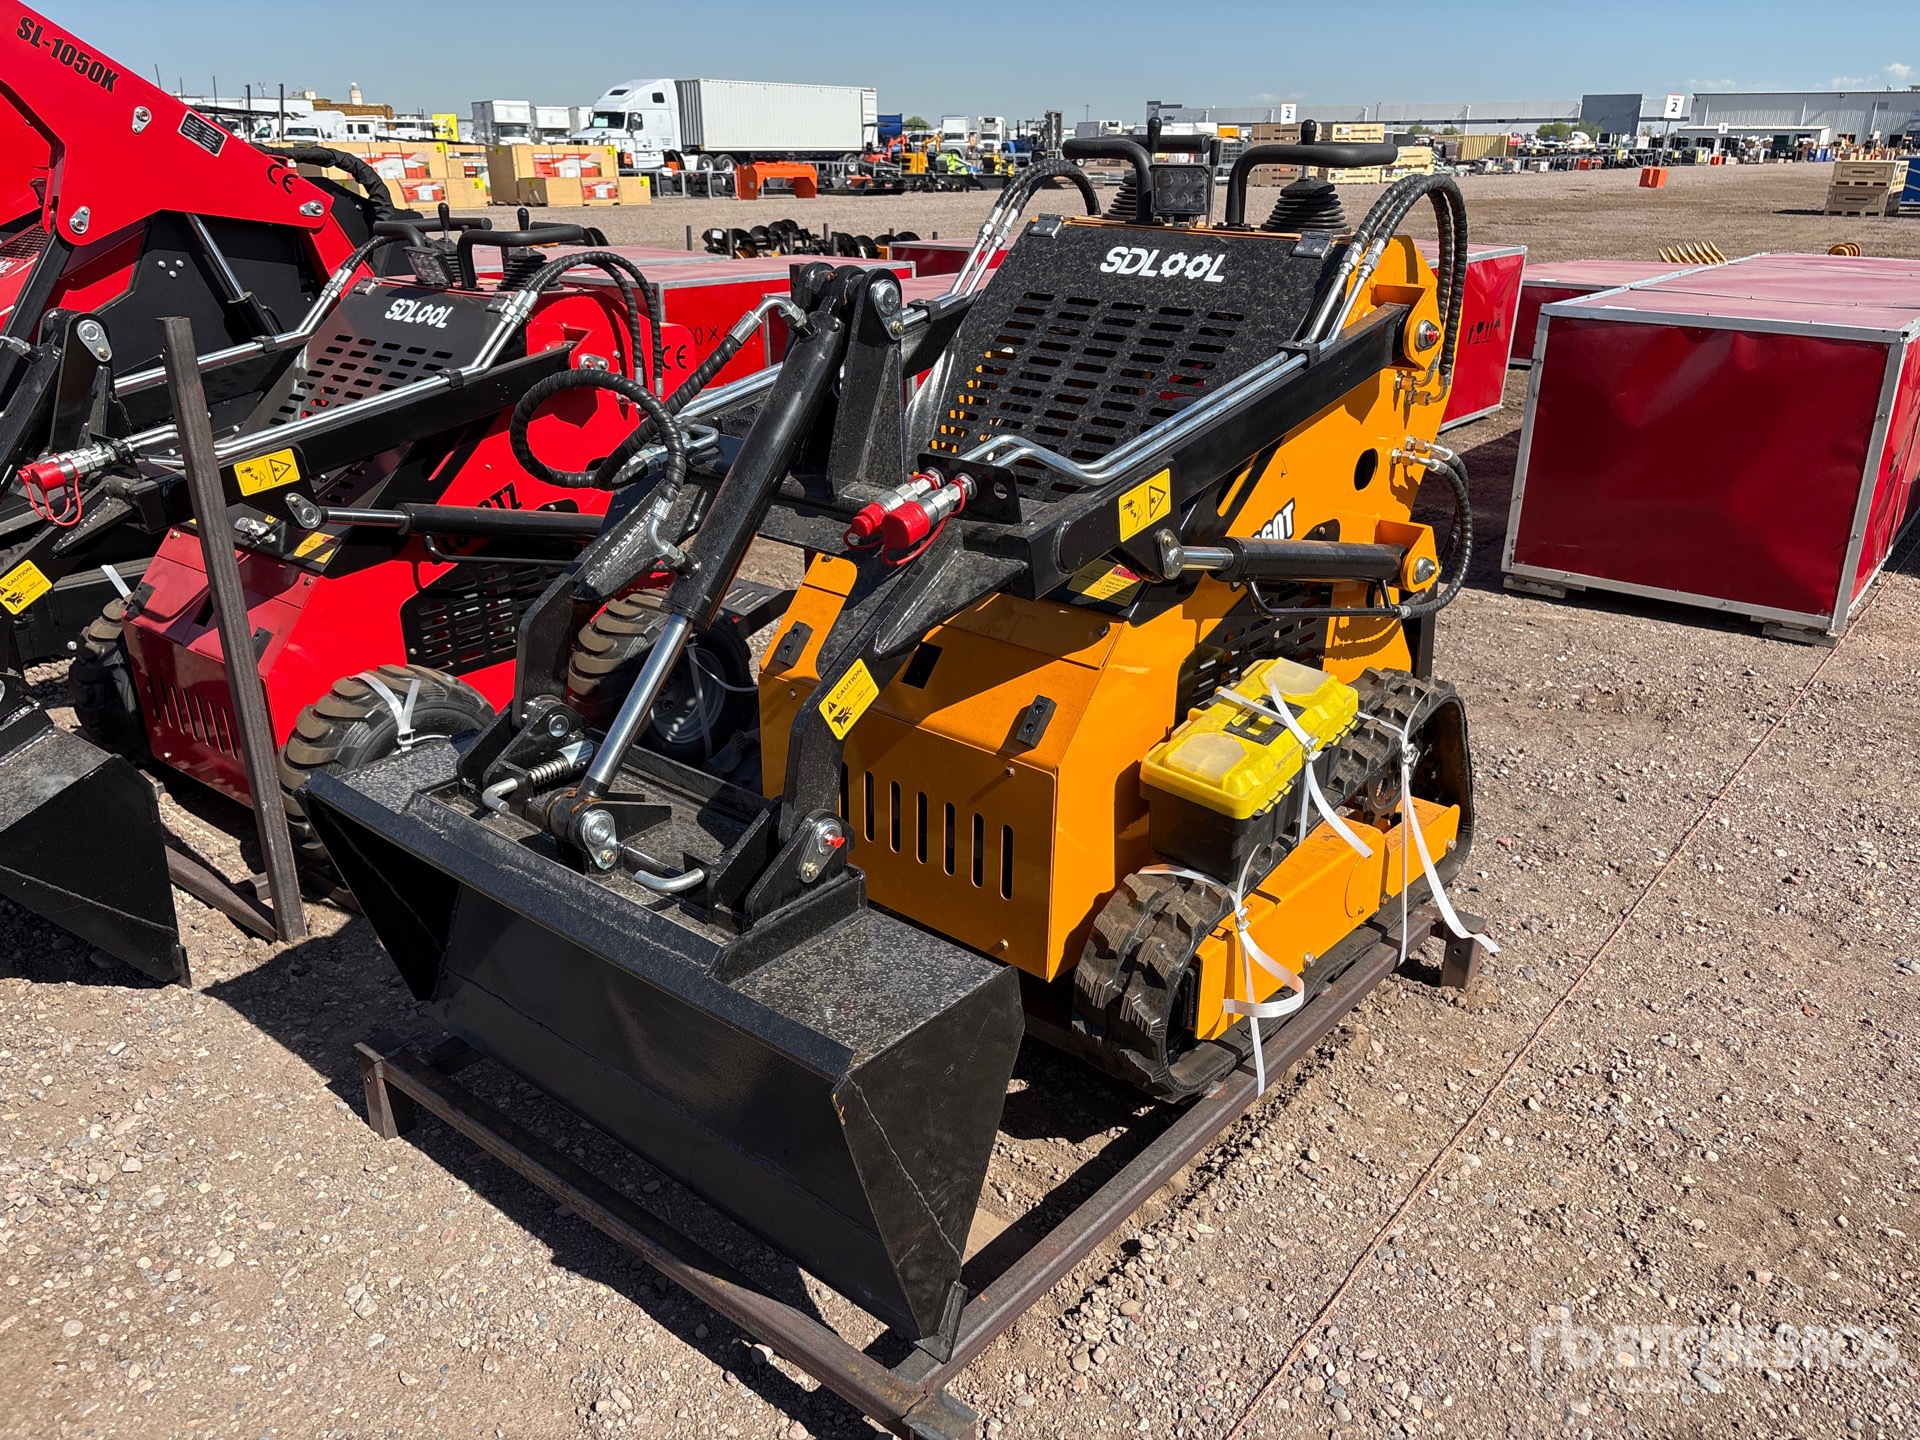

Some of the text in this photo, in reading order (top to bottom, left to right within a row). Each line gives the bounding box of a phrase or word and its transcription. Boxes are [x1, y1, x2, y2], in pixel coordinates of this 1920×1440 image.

[17, 16, 119, 93] SL-1050K
[1285, 110, 1291, 118] 2
[1671, 102, 1678, 112] 2
[1100, 246, 1226, 283] SDLOOL
[384, 298, 454, 329] SDLOOL
[6, 566, 33, 587] CAUTION
[836, 667, 863, 700] CAUTION
